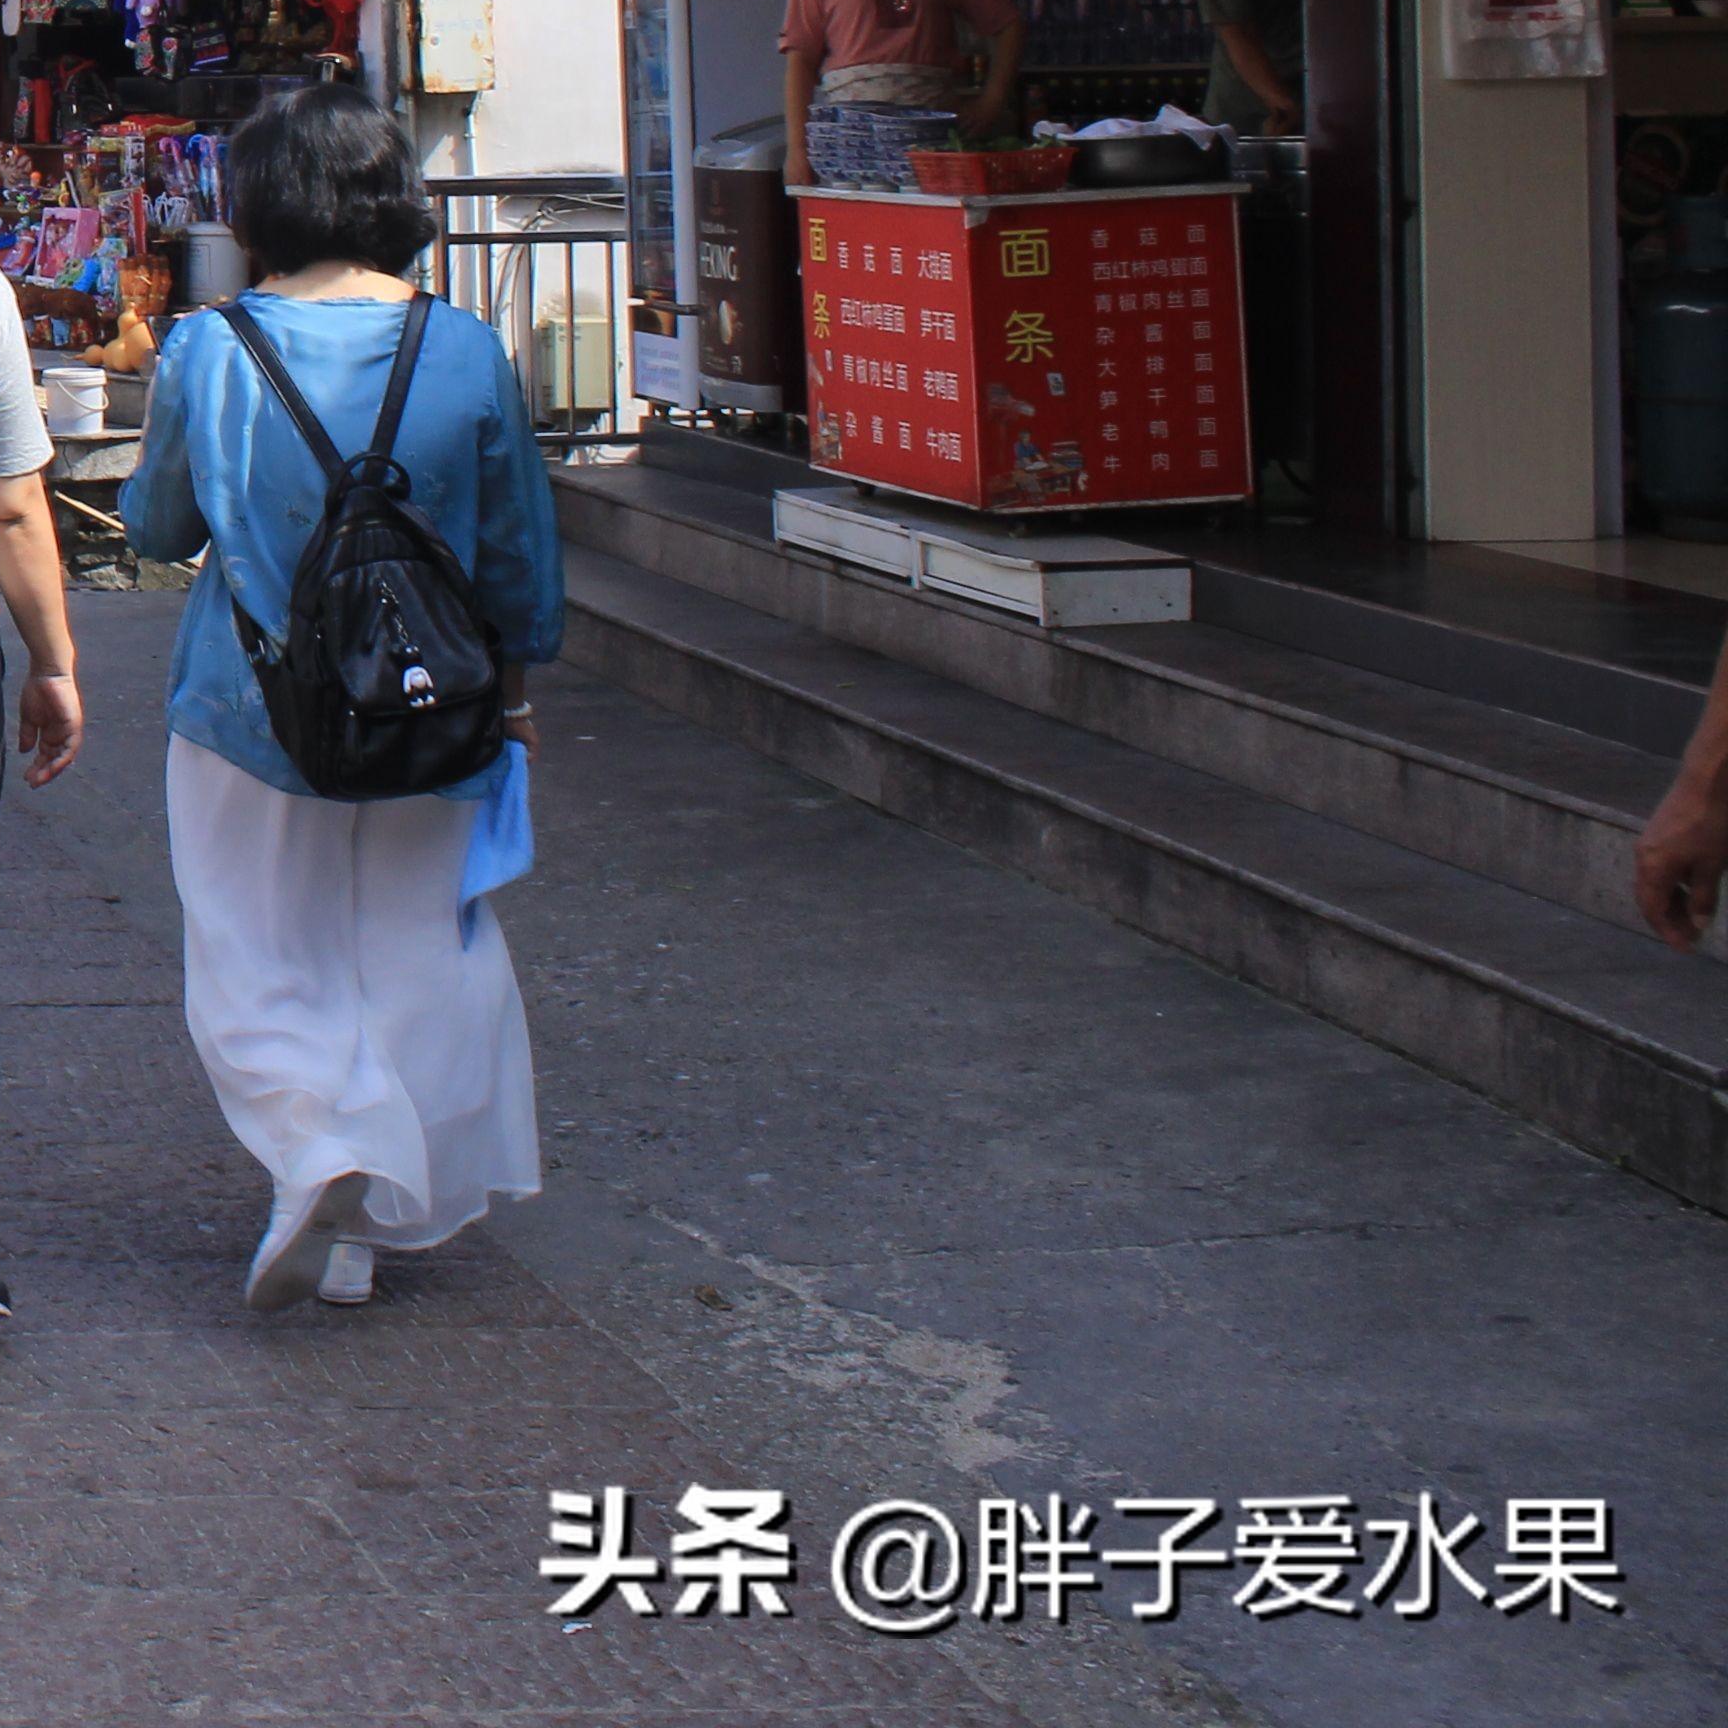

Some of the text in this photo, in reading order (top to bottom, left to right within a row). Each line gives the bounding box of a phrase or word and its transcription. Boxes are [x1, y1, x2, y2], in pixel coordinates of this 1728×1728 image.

[1091, 224, 1206, 249] 香菇面
[838, 241, 903, 275] 香菇面
[917, 249, 953, 281] 大排面
[1093, 256, 1209, 280] 西红柿鸡蛋面
[808, 217, 831, 340] 面条
[998, 228, 1054, 364] 面条
[1095, 288, 1210, 313] 青椒肉丝面
[840, 297, 906, 334] 西红柿鸡蛋面
[1096, 321, 1212, 346] 杂酱面
[1098, 353, 1213, 378] 大排面
[1099, 385, 1215, 409] 笋干面
[926, 427, 962, 463] 牛肉面
[1104, 449, 1219, 473] 牛肉面
